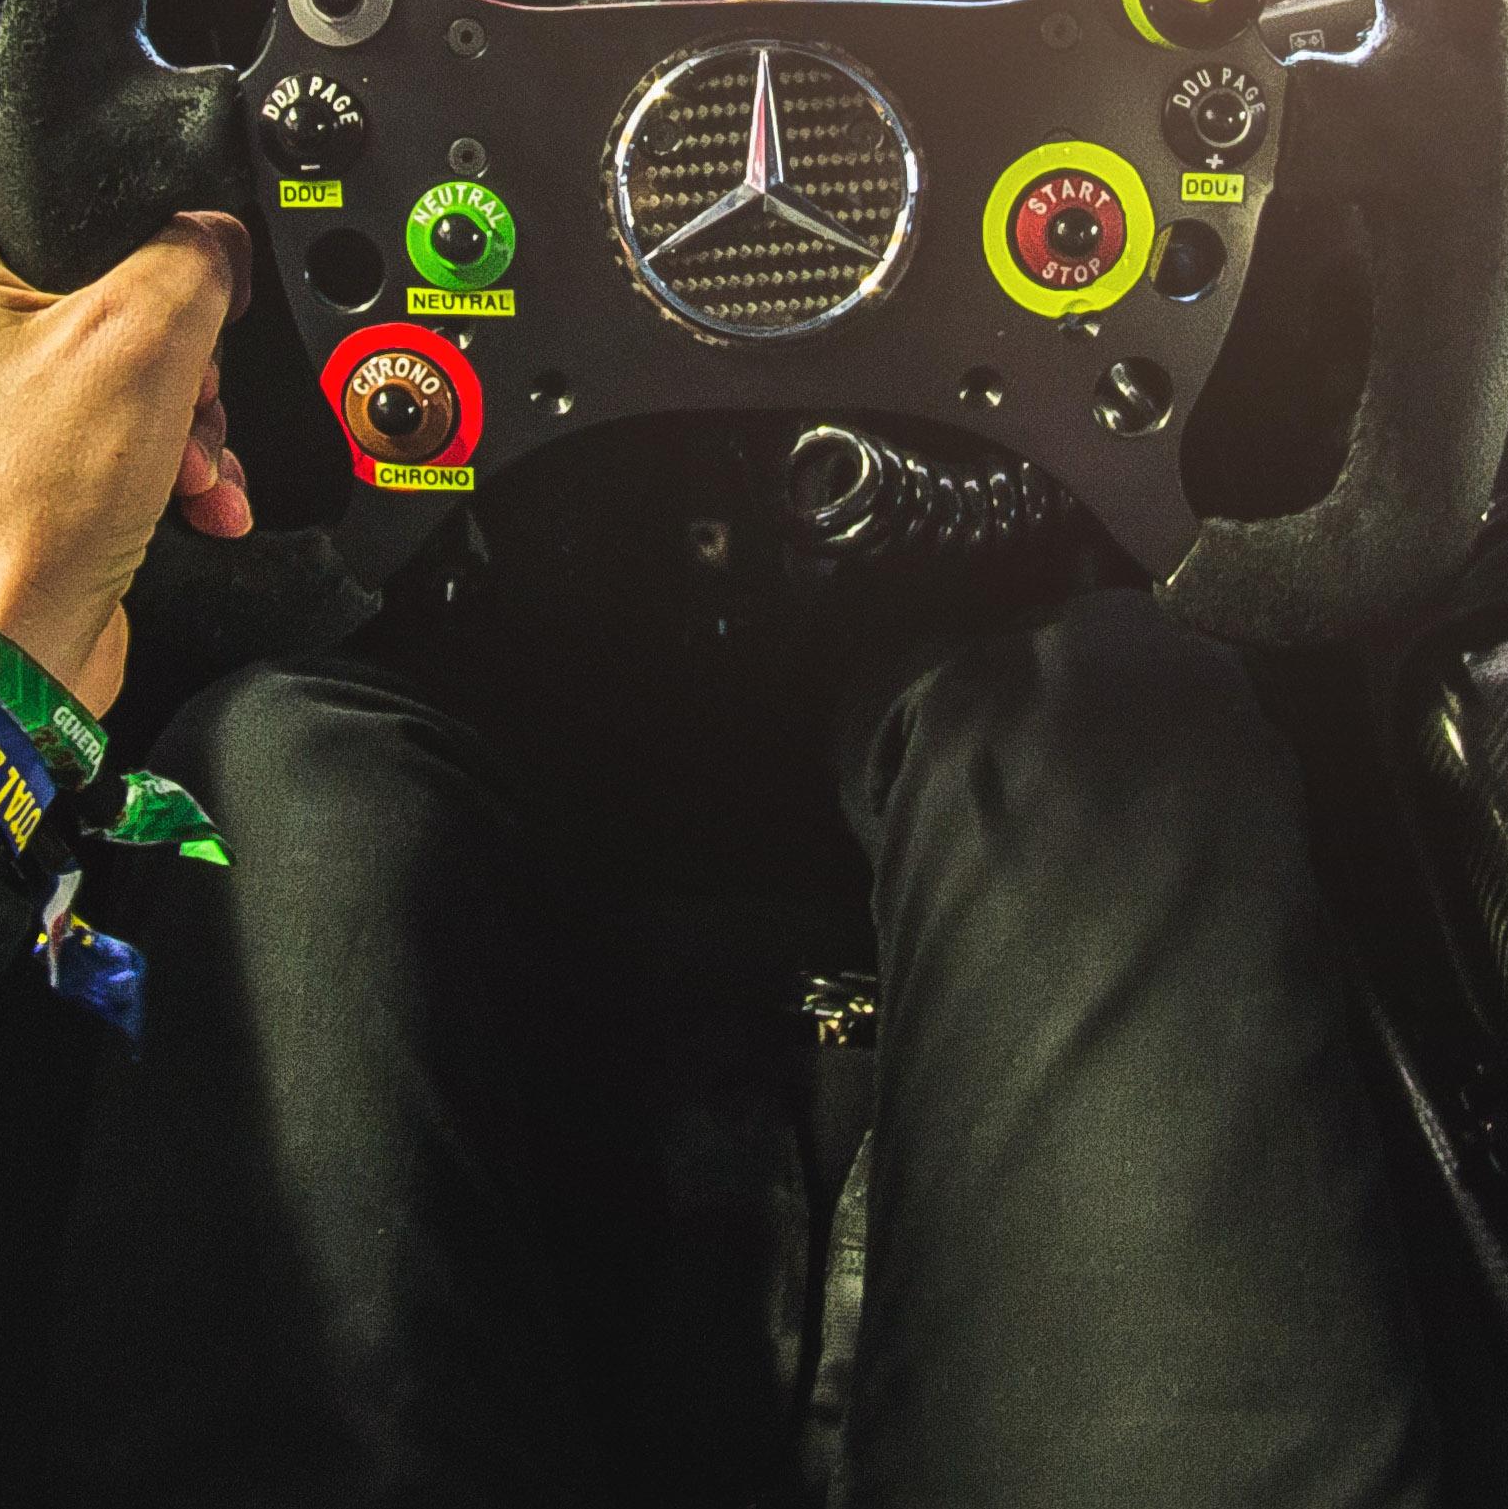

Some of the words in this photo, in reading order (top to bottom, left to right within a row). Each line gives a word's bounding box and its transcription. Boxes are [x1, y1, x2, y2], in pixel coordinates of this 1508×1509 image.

[262, 78, 300, 121] DDU
[309, 75, 359, 125] PAGE
[1172, 68, 1212, 109] DDU
[1221, 67, 1266, 115] PAGE
[1027, 178, 1111, 216] START
[1185, 179, 1240, 196] DDU+
[413, 184, 507, 230] NEUTRAL
[1042, 257, 1102, 285] STOP
[412, 293, 511, 311] NEUTRAL
[352, 357, 441, 397] CHRONO
[379, 468, 471, 488] CHRONO
